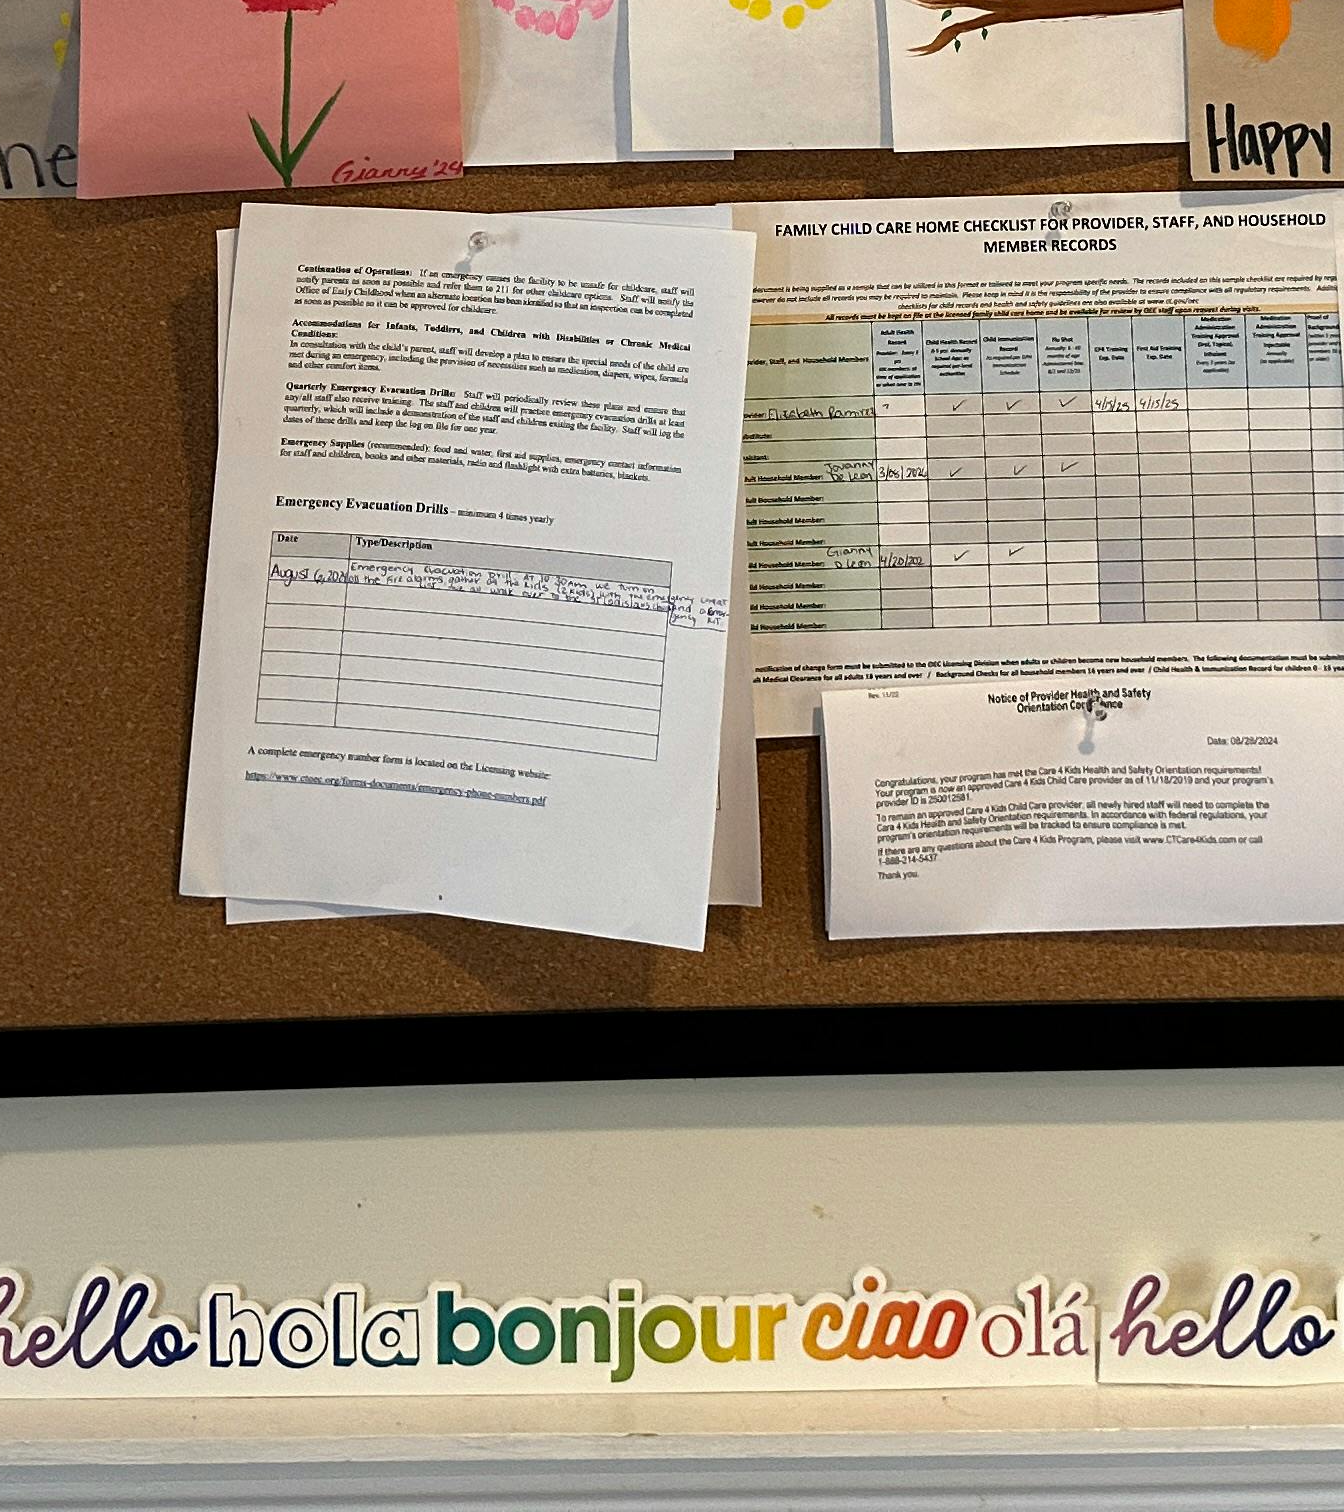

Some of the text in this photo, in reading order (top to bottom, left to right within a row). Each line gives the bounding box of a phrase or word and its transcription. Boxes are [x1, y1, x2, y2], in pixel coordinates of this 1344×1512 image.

[1206, 103, 1331, 177] Happy
[332, 156, 463, 184] Gianny '24
[775, 213, 1326, 237] FAMILY CHILD CARE HOME CHECKLIST FOR PROVIDER, STAFF, AND HOUSEHOLD
[983, 238, 1117, 254] MEMBER RECORDS
[275, 495, 555, 527] Emergency Evacuation Drills minimum 4 times yearly
[277, 533, 299, 543] Date
[355, 535, 435, 552] Type/Description
[988, 687, 1151, 704] Notice of Provider Health and Safety
[1017, 701, 1068, 713] Orientation
[1109, 1272, 1336, 1357] hello
[210, 1290, 422, 1368] hola
[437, 1287, 789, 1384] bonjour
[803, 1275, 970, 1361] ciao
[979, 1285, 1087, 1358] olá
